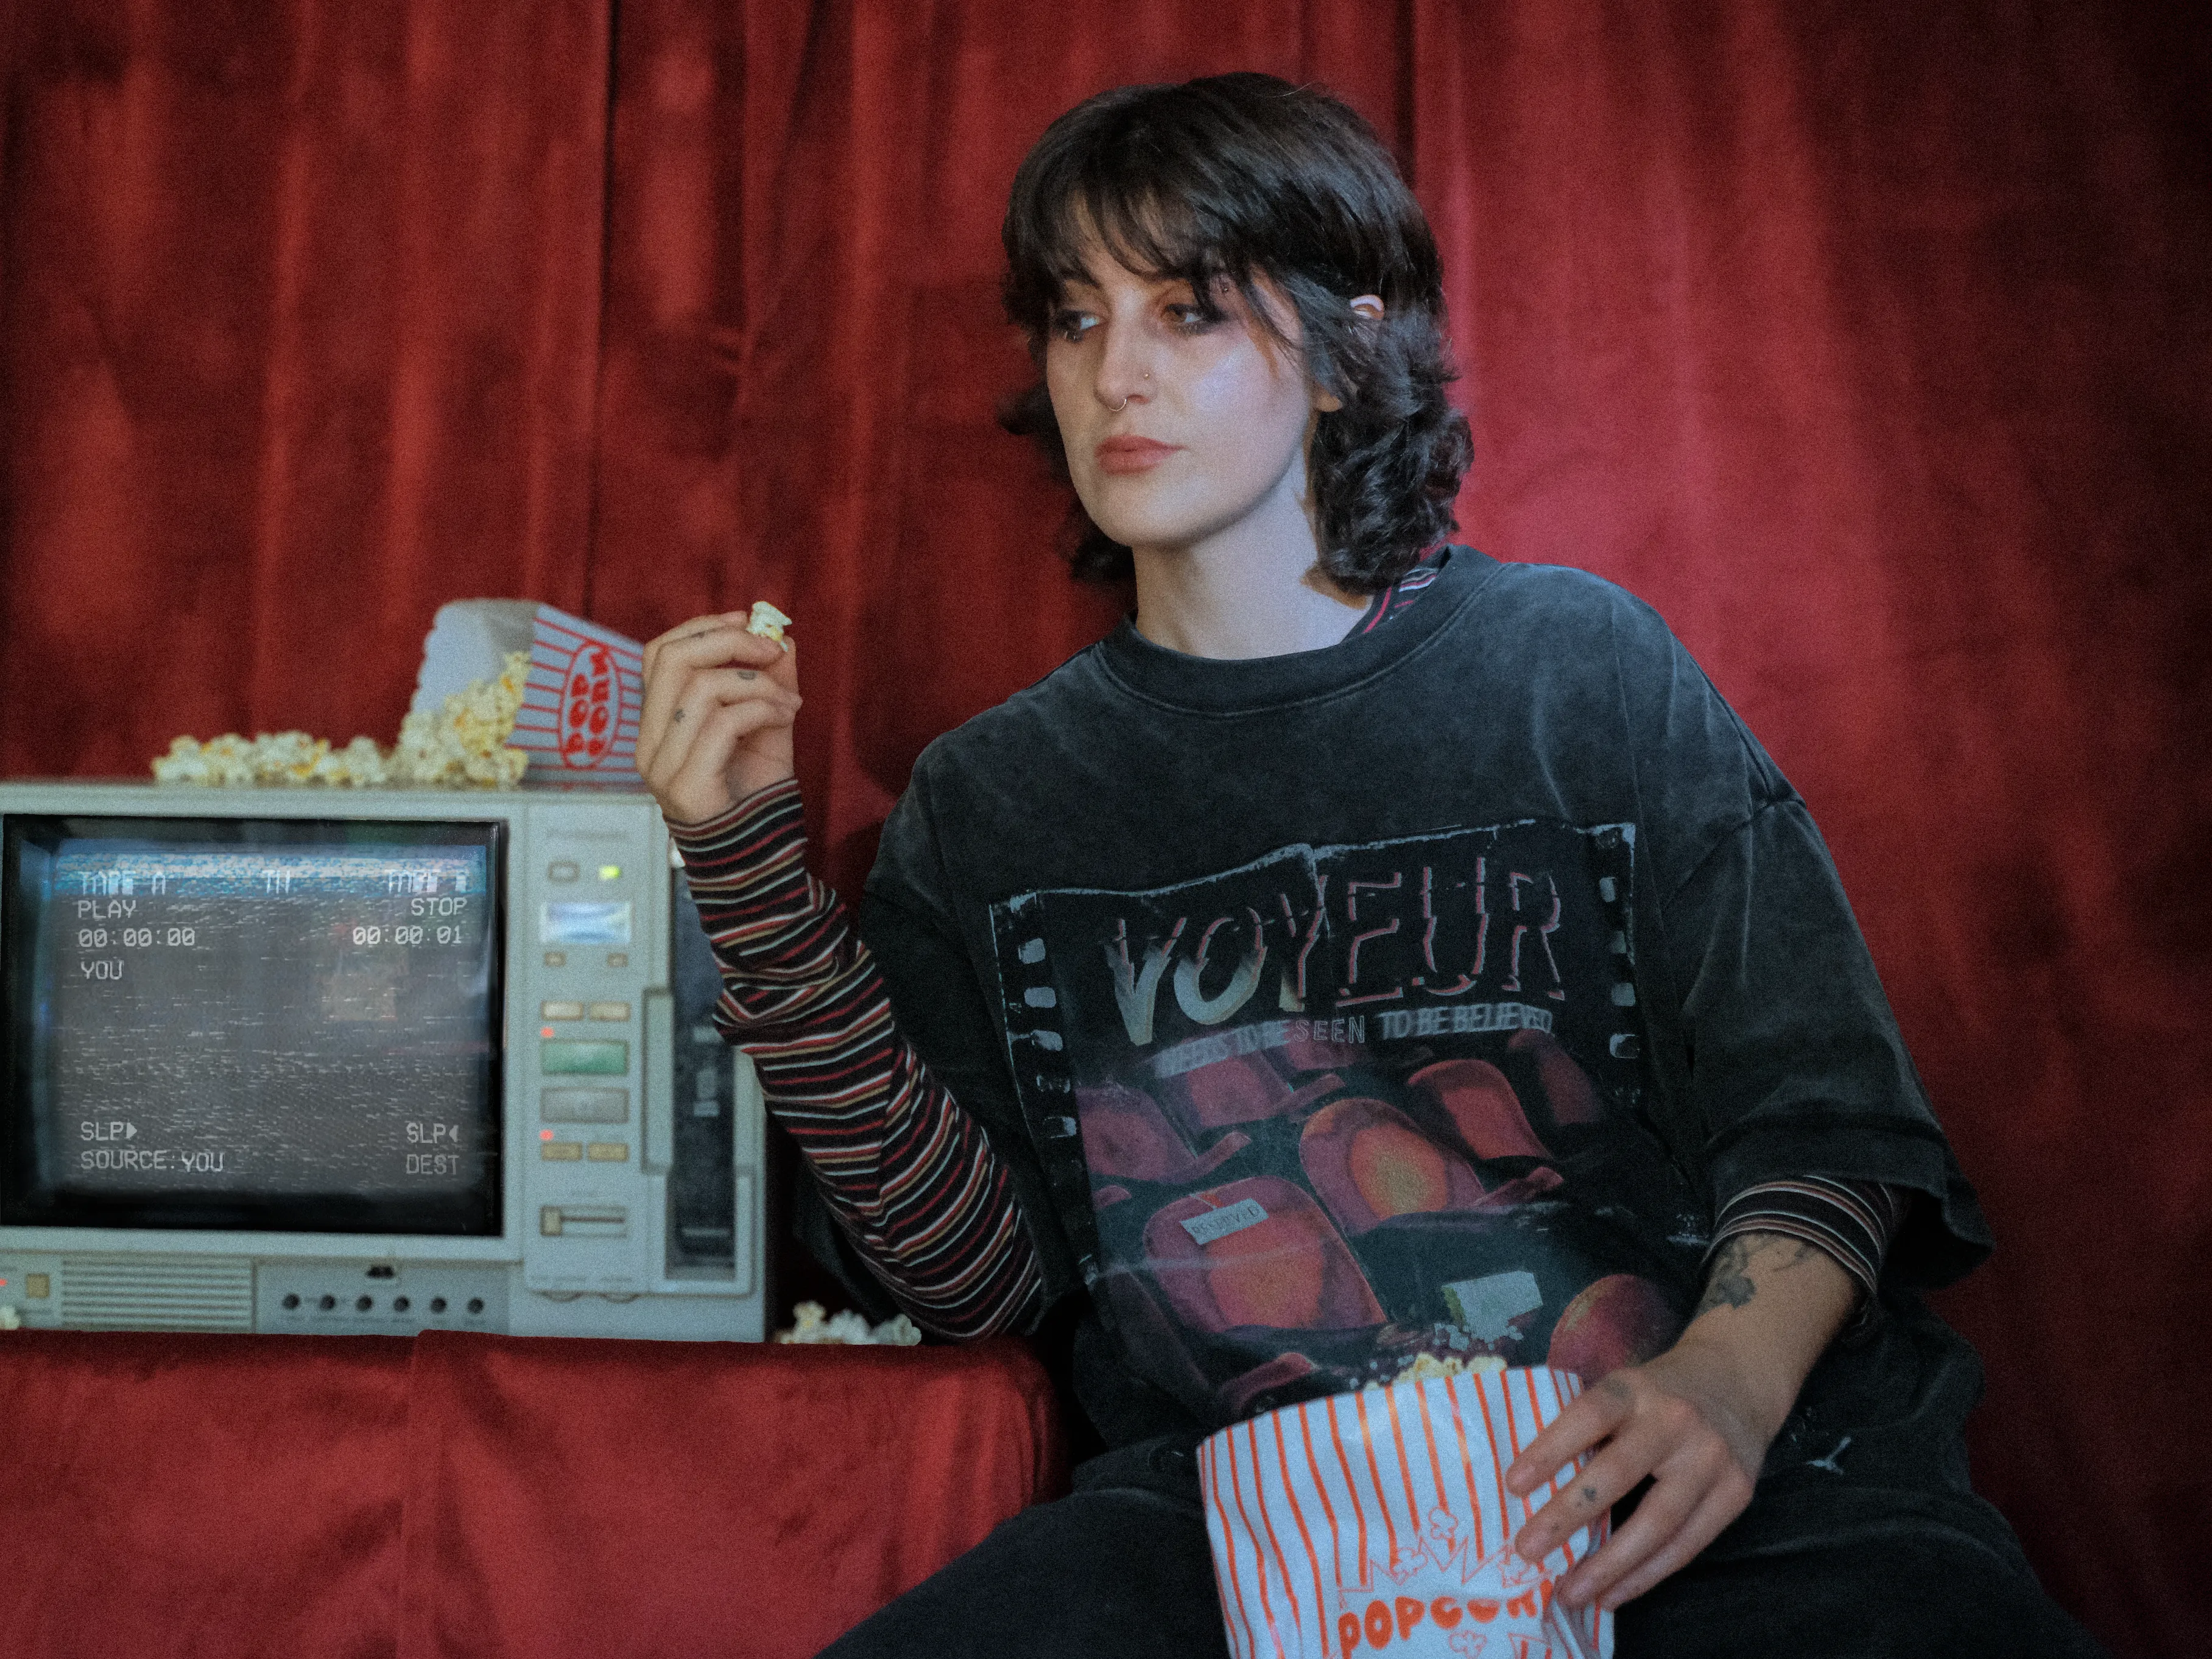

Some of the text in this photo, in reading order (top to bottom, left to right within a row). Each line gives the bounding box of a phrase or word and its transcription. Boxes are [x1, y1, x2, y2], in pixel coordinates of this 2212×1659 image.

[564, 674, 590, 755] POP
[77, 900, 138, 920] PLAY
[410, 898, 468, 917] STOP
[79, 928, 196, 947] 00:00:00
[353, 926, 462, 945] 00:00:01
[1104, 856, 1565, 1046] VOYEUR
[81, 960, 124, 981] YOU
[1292, 1015, 1365, 1044] SEEN
[1377, 1011, 1411, 1040] TO
[1415, 1006, 1451, 1037] BE
[80, 1121, 124, 1141] SLP
[406, 1122, 446, 1144] SLP
[406, 1154, 459, 1175] DEST
